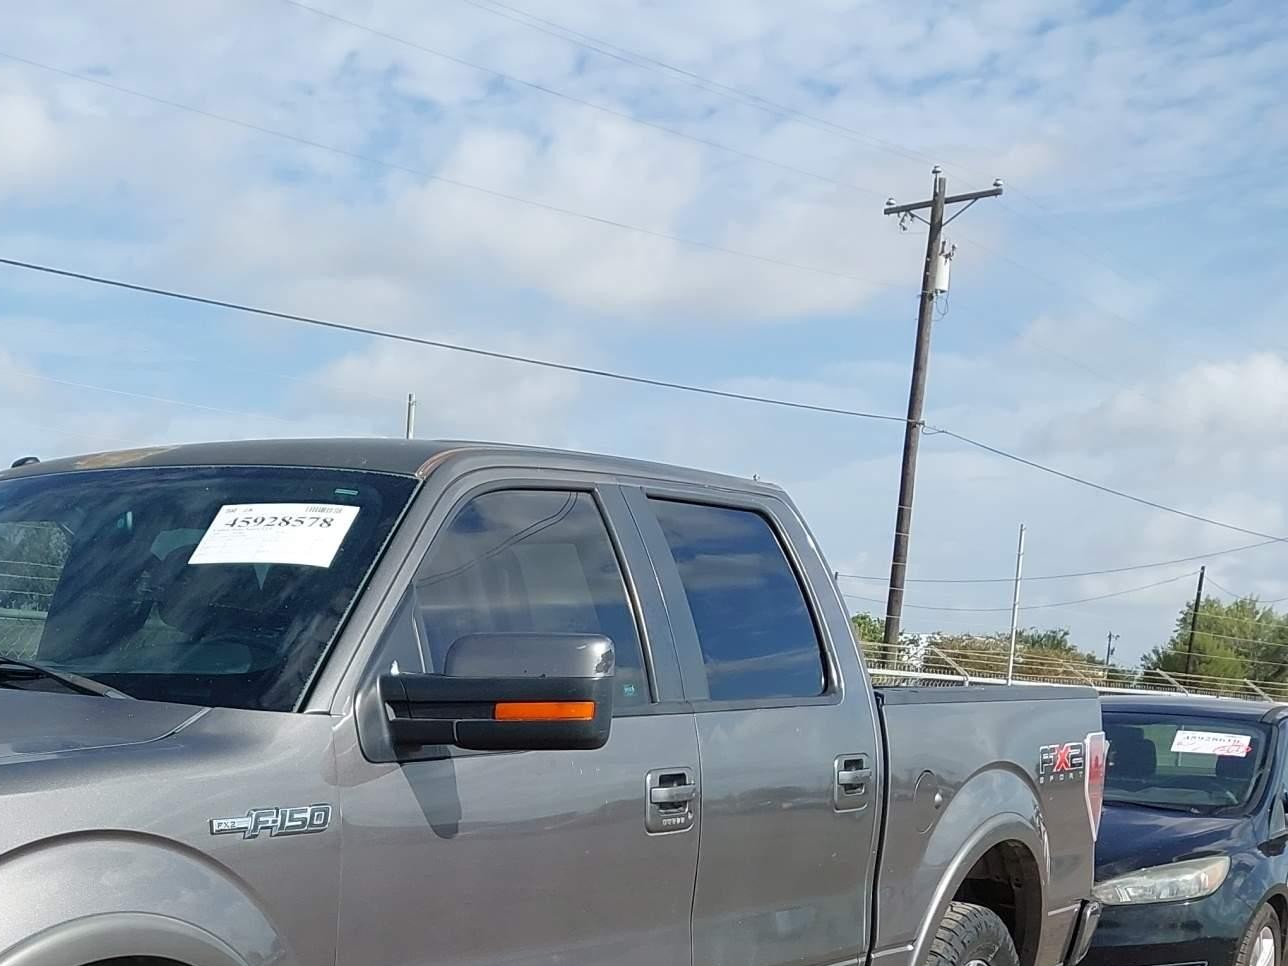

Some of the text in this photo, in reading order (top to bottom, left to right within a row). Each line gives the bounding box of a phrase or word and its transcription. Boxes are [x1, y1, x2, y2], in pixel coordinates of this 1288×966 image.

[224, 515, 335, 529] 45928578
[1040, 743, 1083, 774] FX2
[216, 821, 237, 829] FX2
